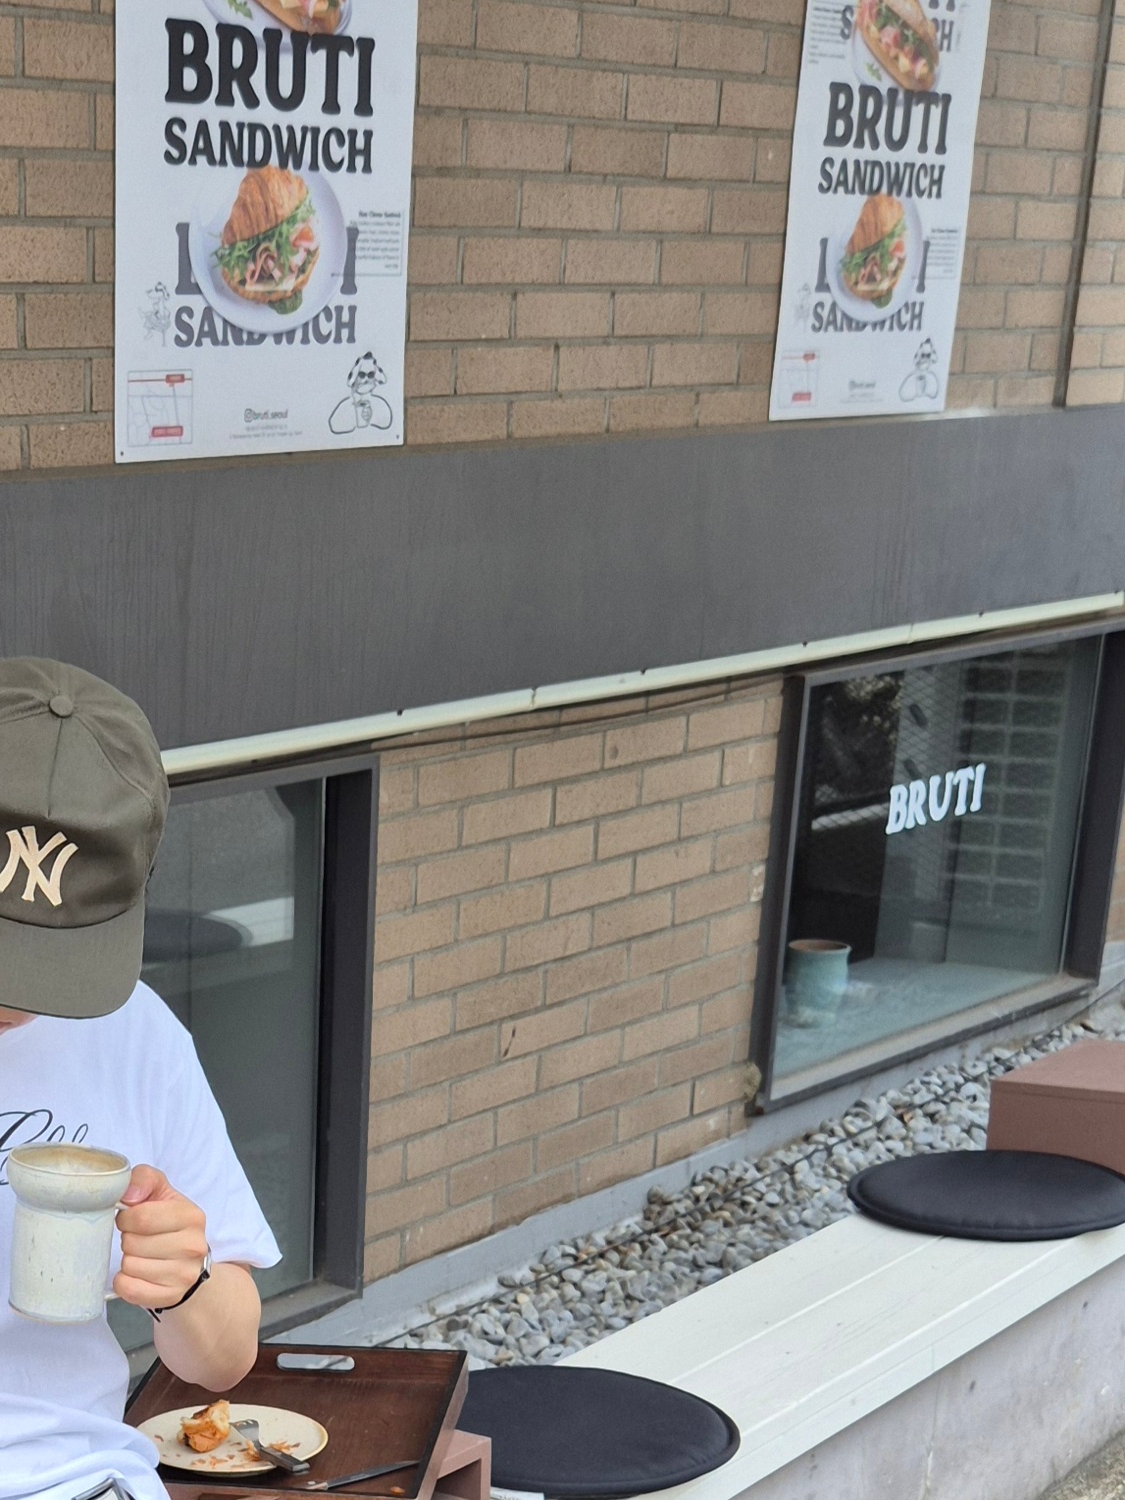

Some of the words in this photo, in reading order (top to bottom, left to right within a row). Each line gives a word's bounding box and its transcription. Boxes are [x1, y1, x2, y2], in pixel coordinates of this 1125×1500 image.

[164, 18, 375, 117] BRUTI
[163, 118, 373, 174] SANDWICH
[823, 81, 952, 155] BRUTI
[818, 157, 945, 199] SANDWICH
[885, 762, 987, 835] BRUTI
